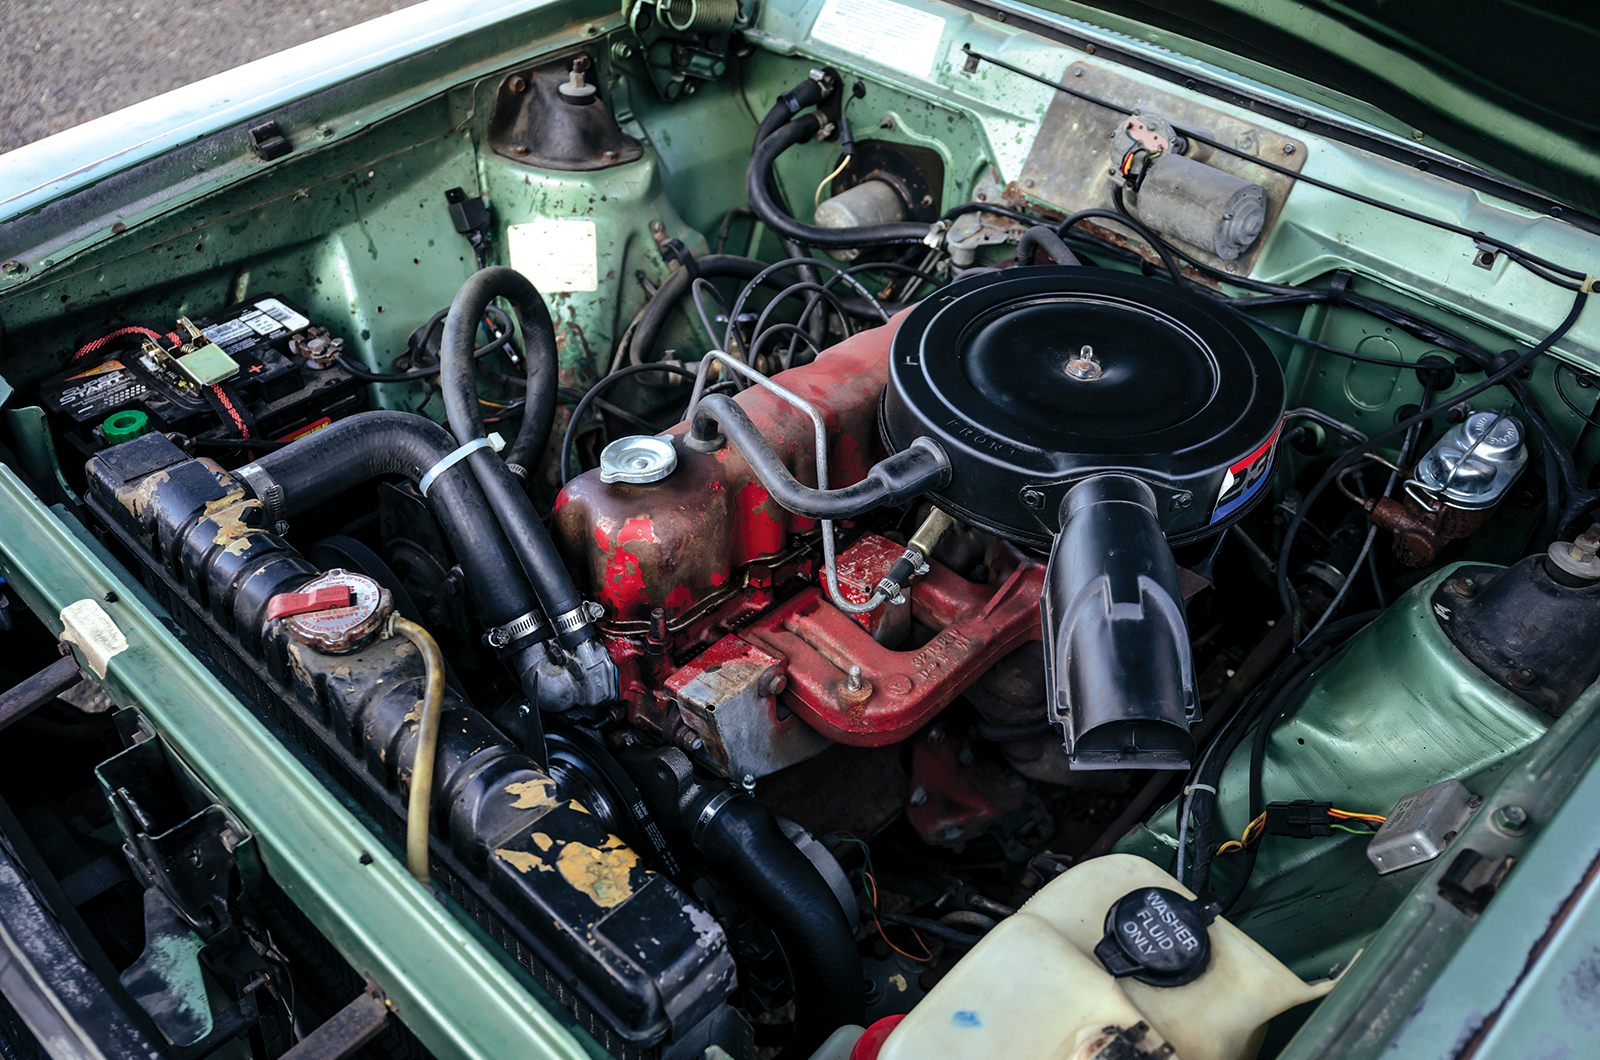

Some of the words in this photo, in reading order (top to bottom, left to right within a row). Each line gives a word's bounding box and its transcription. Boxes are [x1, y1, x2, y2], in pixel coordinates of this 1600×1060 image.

[62, 370, 121, 395] SUPER
[946, 419, 1017, 456] FRONT
[301, 621, 312, 629] CAP
[311, 623, 335, 632] UNLOCK
[1123, 921, 1157, 956] ONLY
[1136, 909, 1174, 950] FLUID
[1147, 891, 1199, 951] WASHER
